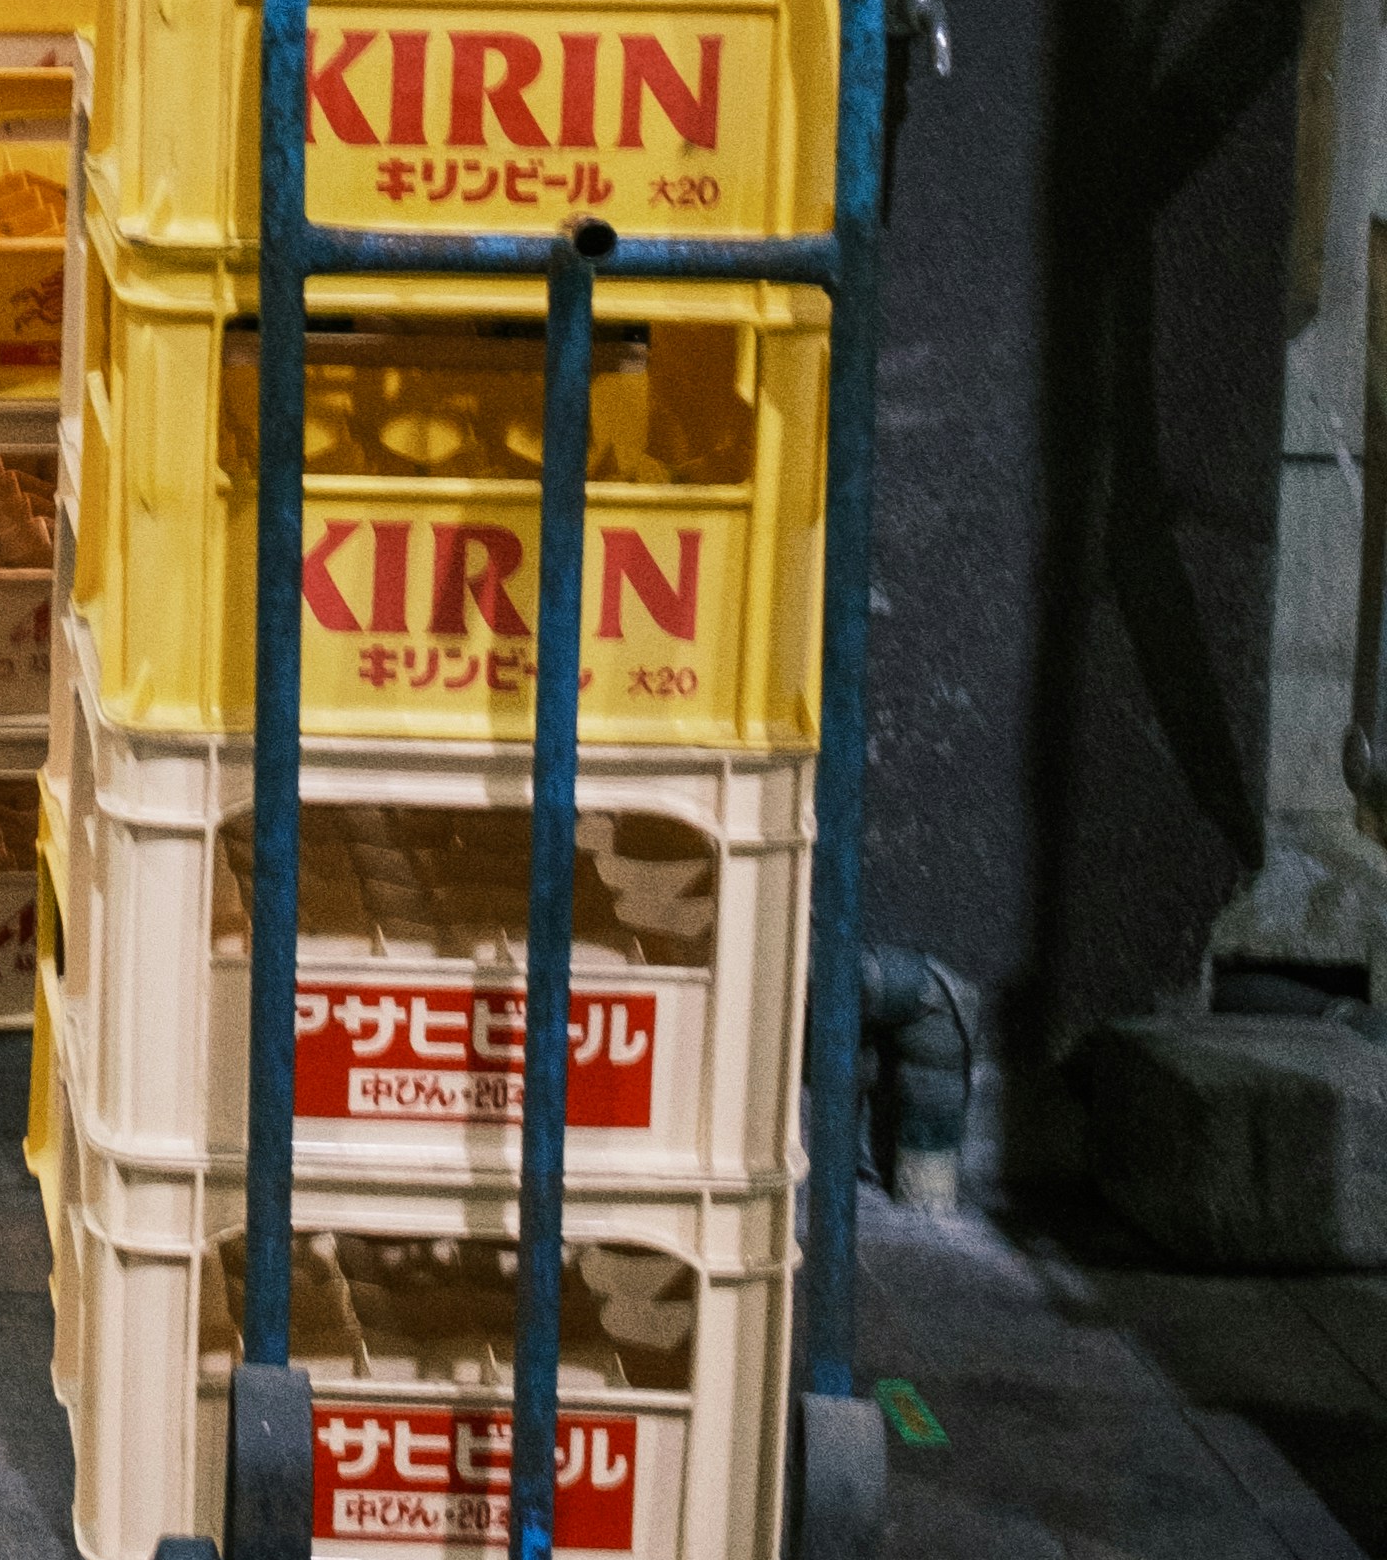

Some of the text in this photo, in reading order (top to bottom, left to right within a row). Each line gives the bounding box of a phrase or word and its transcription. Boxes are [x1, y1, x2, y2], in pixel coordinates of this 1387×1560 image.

[305, 29, 725, 150] KIRIN
[375, 156, 721, 208] キリンビール 大20
[302, 519, 703, 641] KIRN
[359, 644, 699, 697] キリンビ 大20
